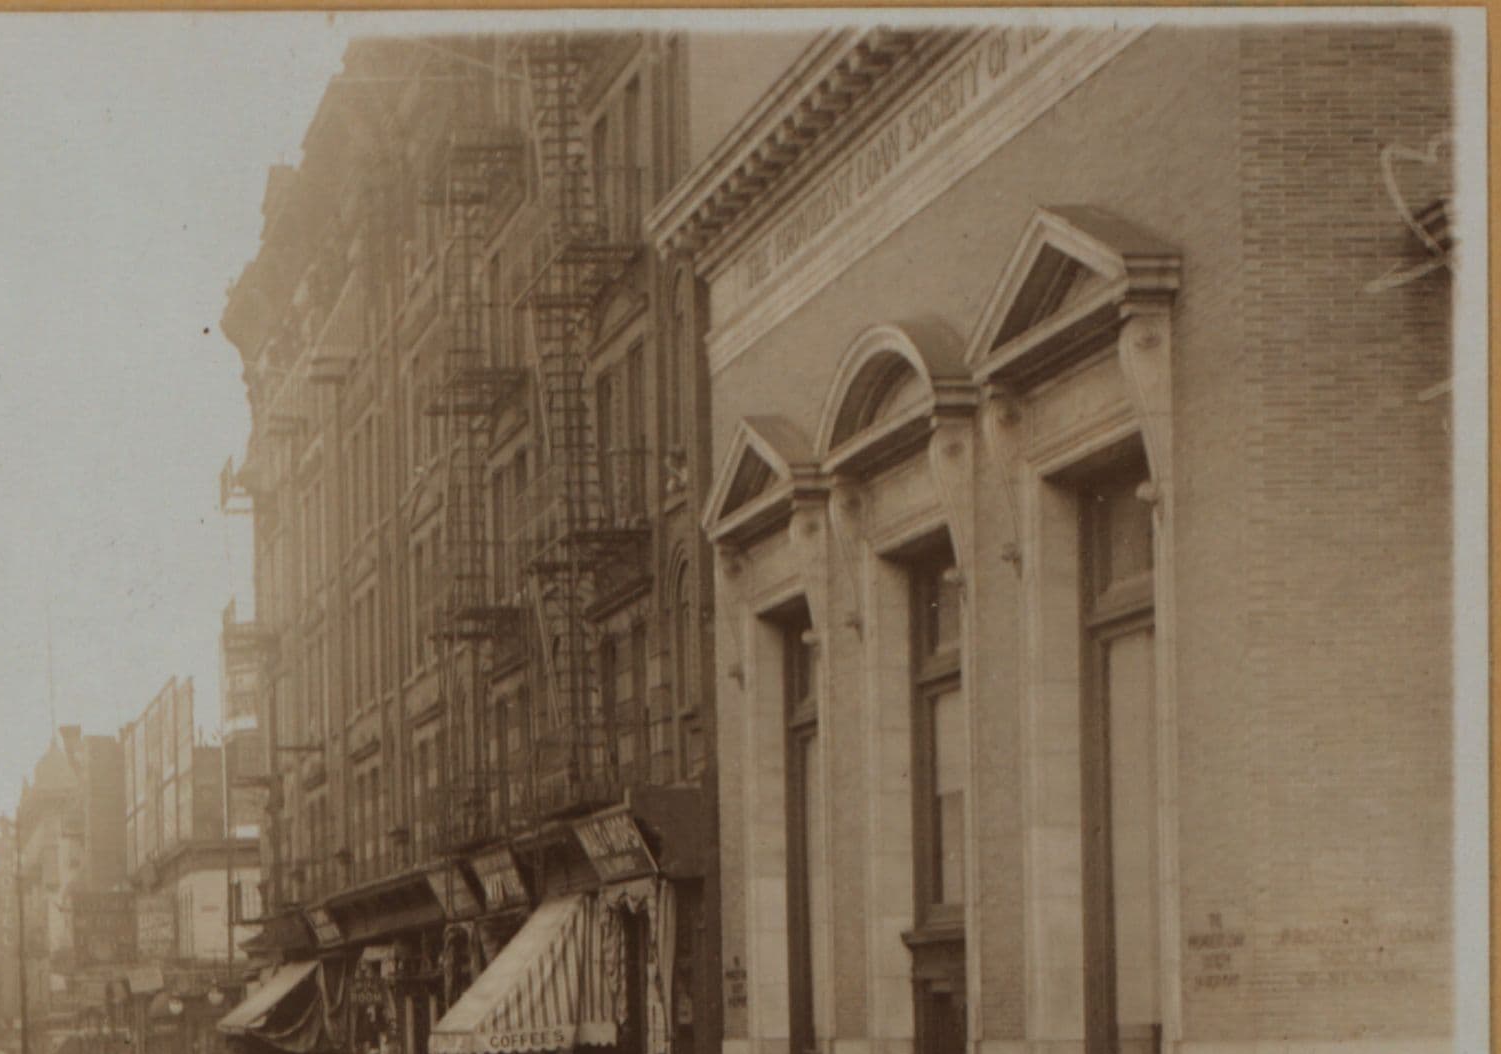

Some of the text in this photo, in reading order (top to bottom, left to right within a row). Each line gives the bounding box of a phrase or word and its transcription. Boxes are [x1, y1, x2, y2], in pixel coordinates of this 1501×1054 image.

[857, 127, 901, 195] LOAN
[907, 53, 981, 150] SOCIETY
[987, 28, 1009, 80] OF
[489, 1030, 565, 1049] COFFEES
